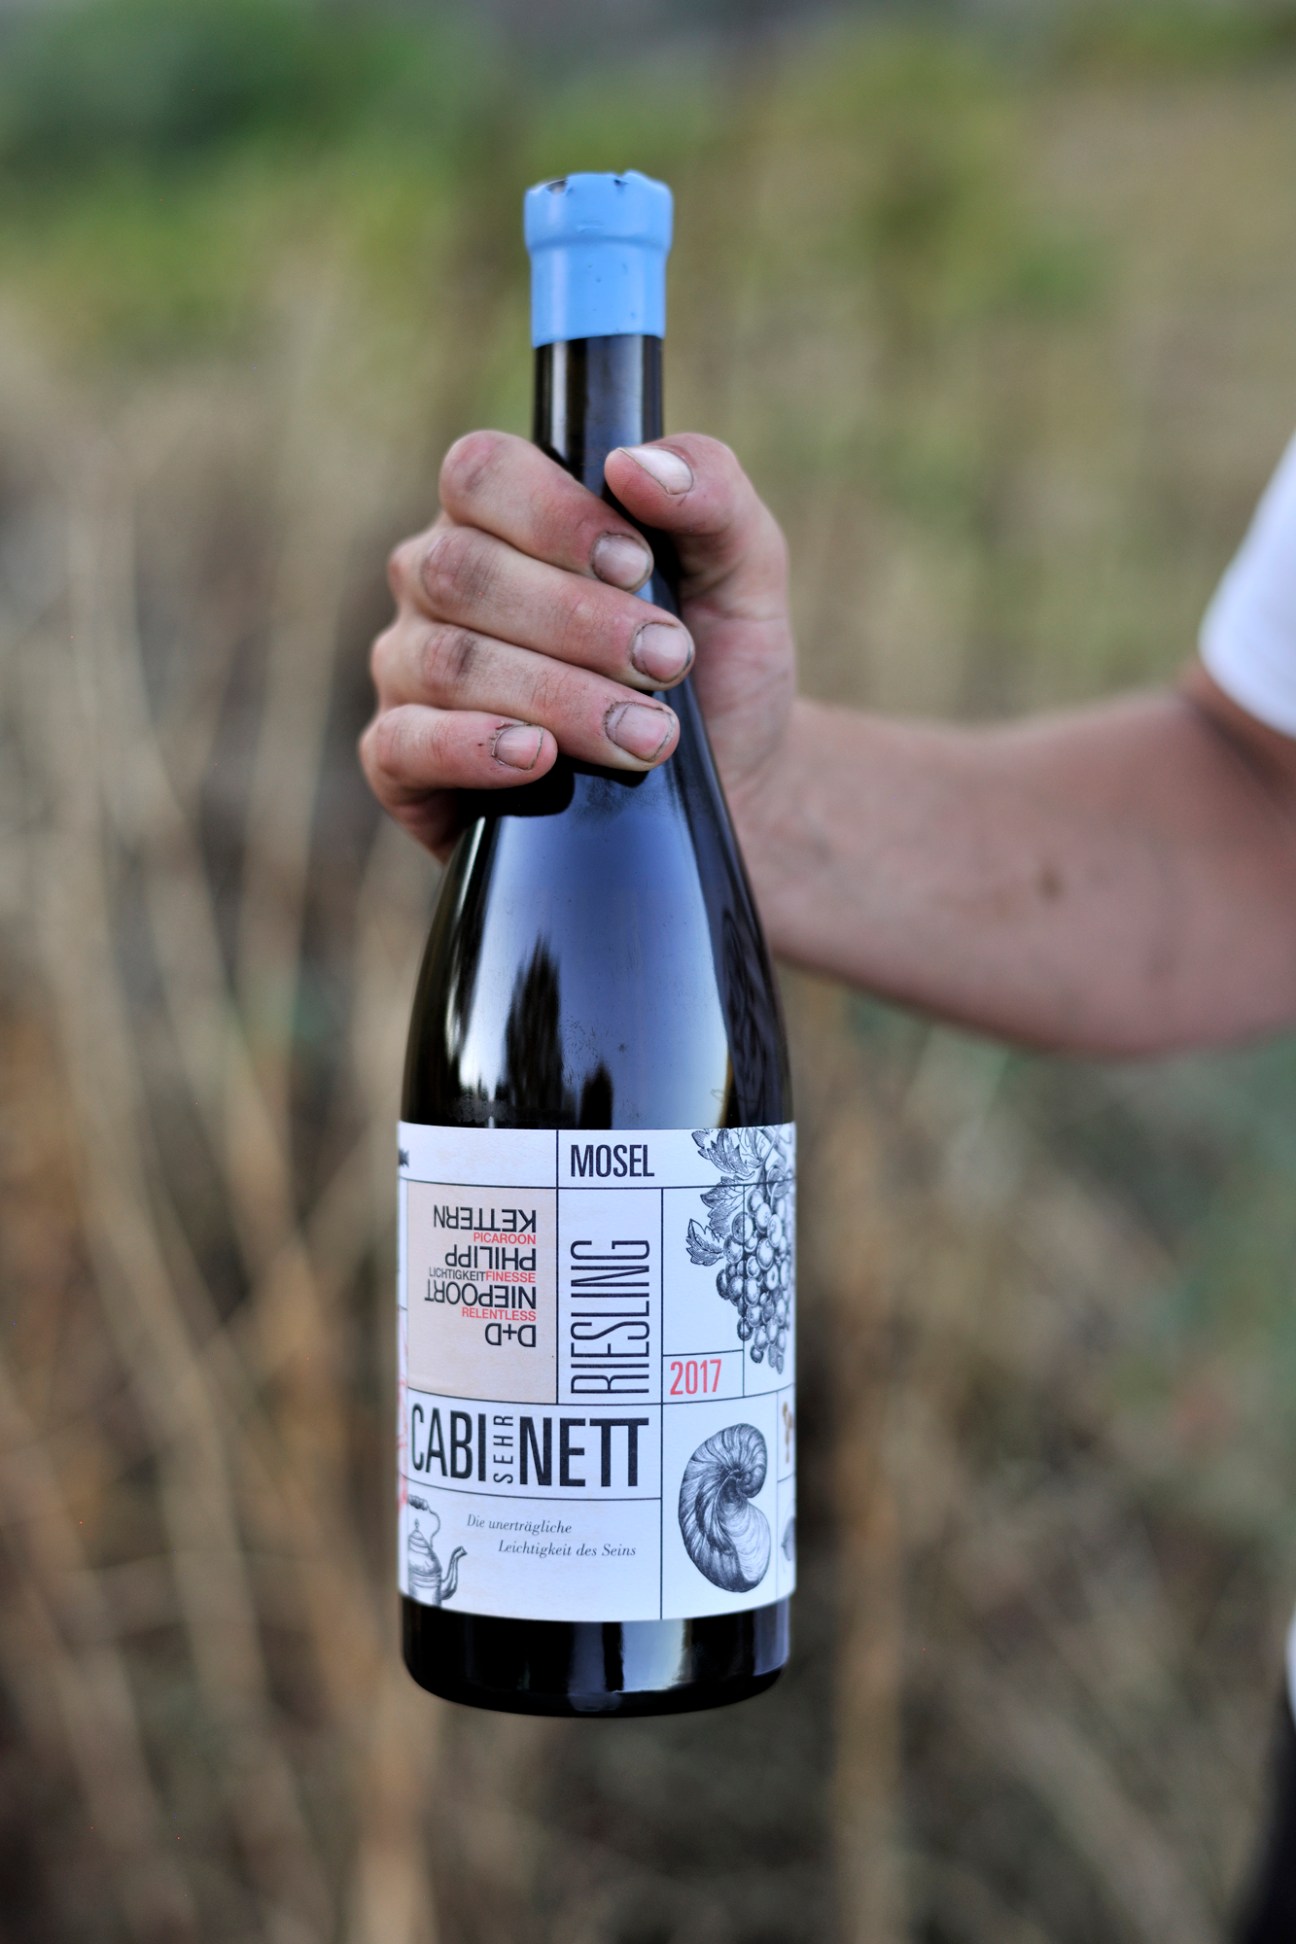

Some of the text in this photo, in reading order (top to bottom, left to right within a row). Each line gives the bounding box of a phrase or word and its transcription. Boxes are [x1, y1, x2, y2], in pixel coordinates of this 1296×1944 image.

[571, 1144, 655, 1178] MOSEL
[433, 1204, 536, 1233] KETTERN
[473, 1232, 536, 1245] PICAROON
[445, 1244, 536, 1271] PHILIPP
[424, 1278, 536, 1309] NIEPOORT
[461, 1307, 536, 1322] RELENTLESS
[570, 1239, 650, 1394] RIESLING
[484, 1322, 536, 1348] D+D
[669, 1358, 723, 1395] 2017
[411, 1402, 650, 1488] CABI SEHR NETT
[466, 1513, 572, 1535] Die unerträgliche
[498, 1539, 637, 1558] Leichtigkeit des Seins
